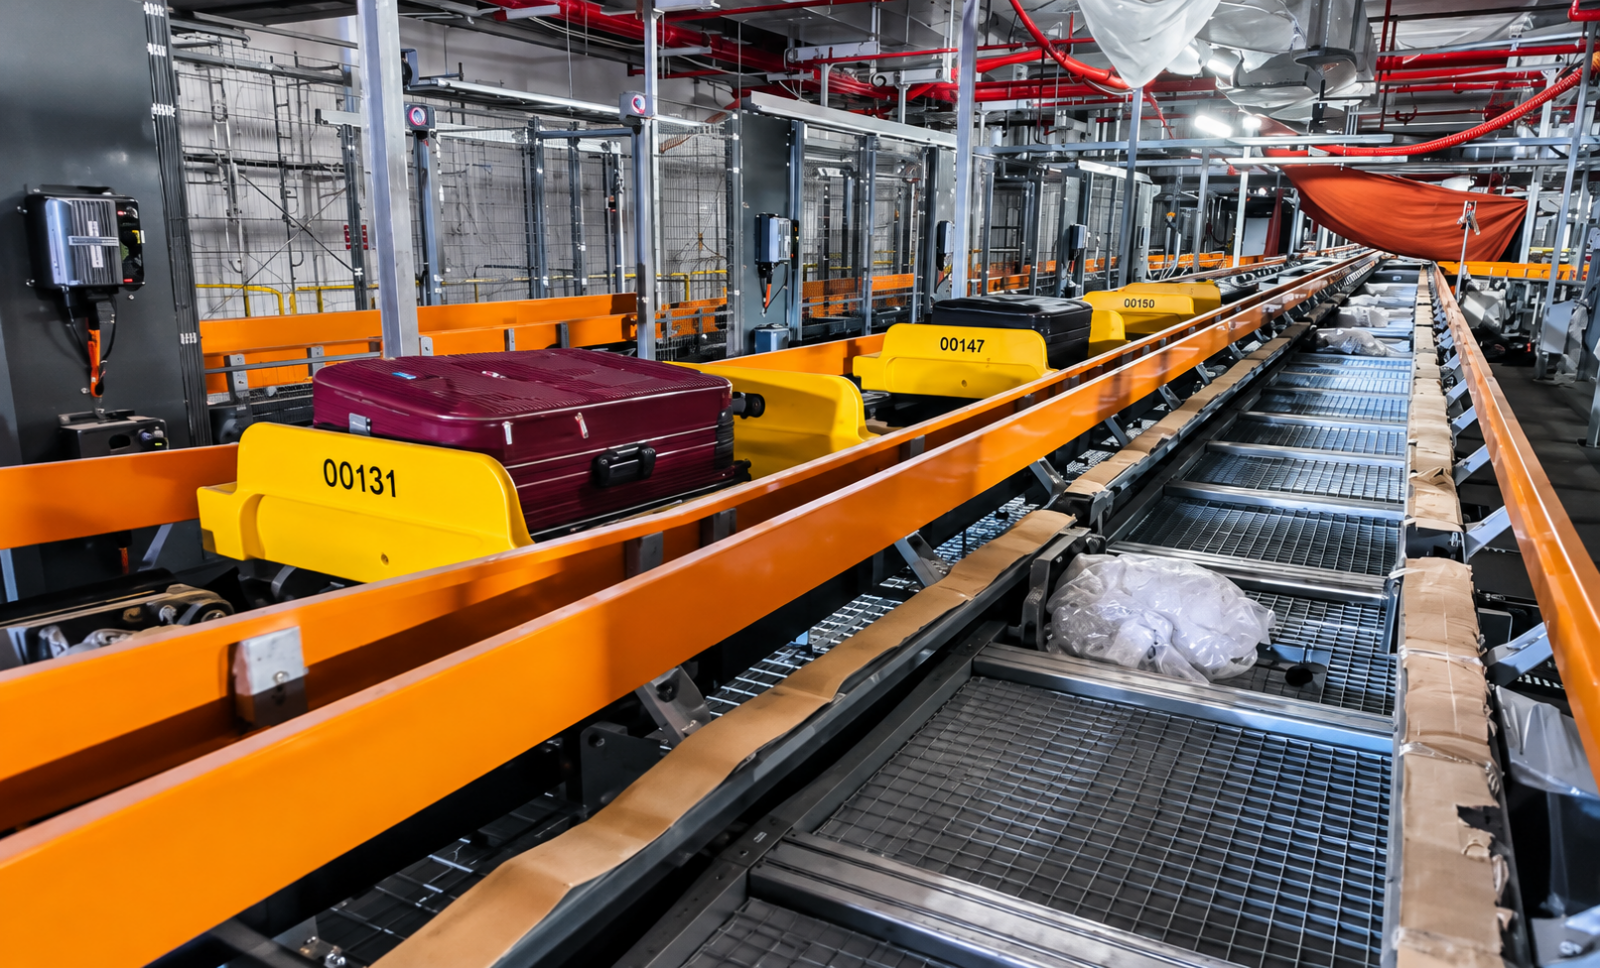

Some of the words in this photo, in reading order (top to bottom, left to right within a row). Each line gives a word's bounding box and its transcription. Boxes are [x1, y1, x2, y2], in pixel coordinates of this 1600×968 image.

[1124, 298, 1155, 308] 00150
[940, 337, 985, 352] 00147
[323, 458, 396, 497] 00131
